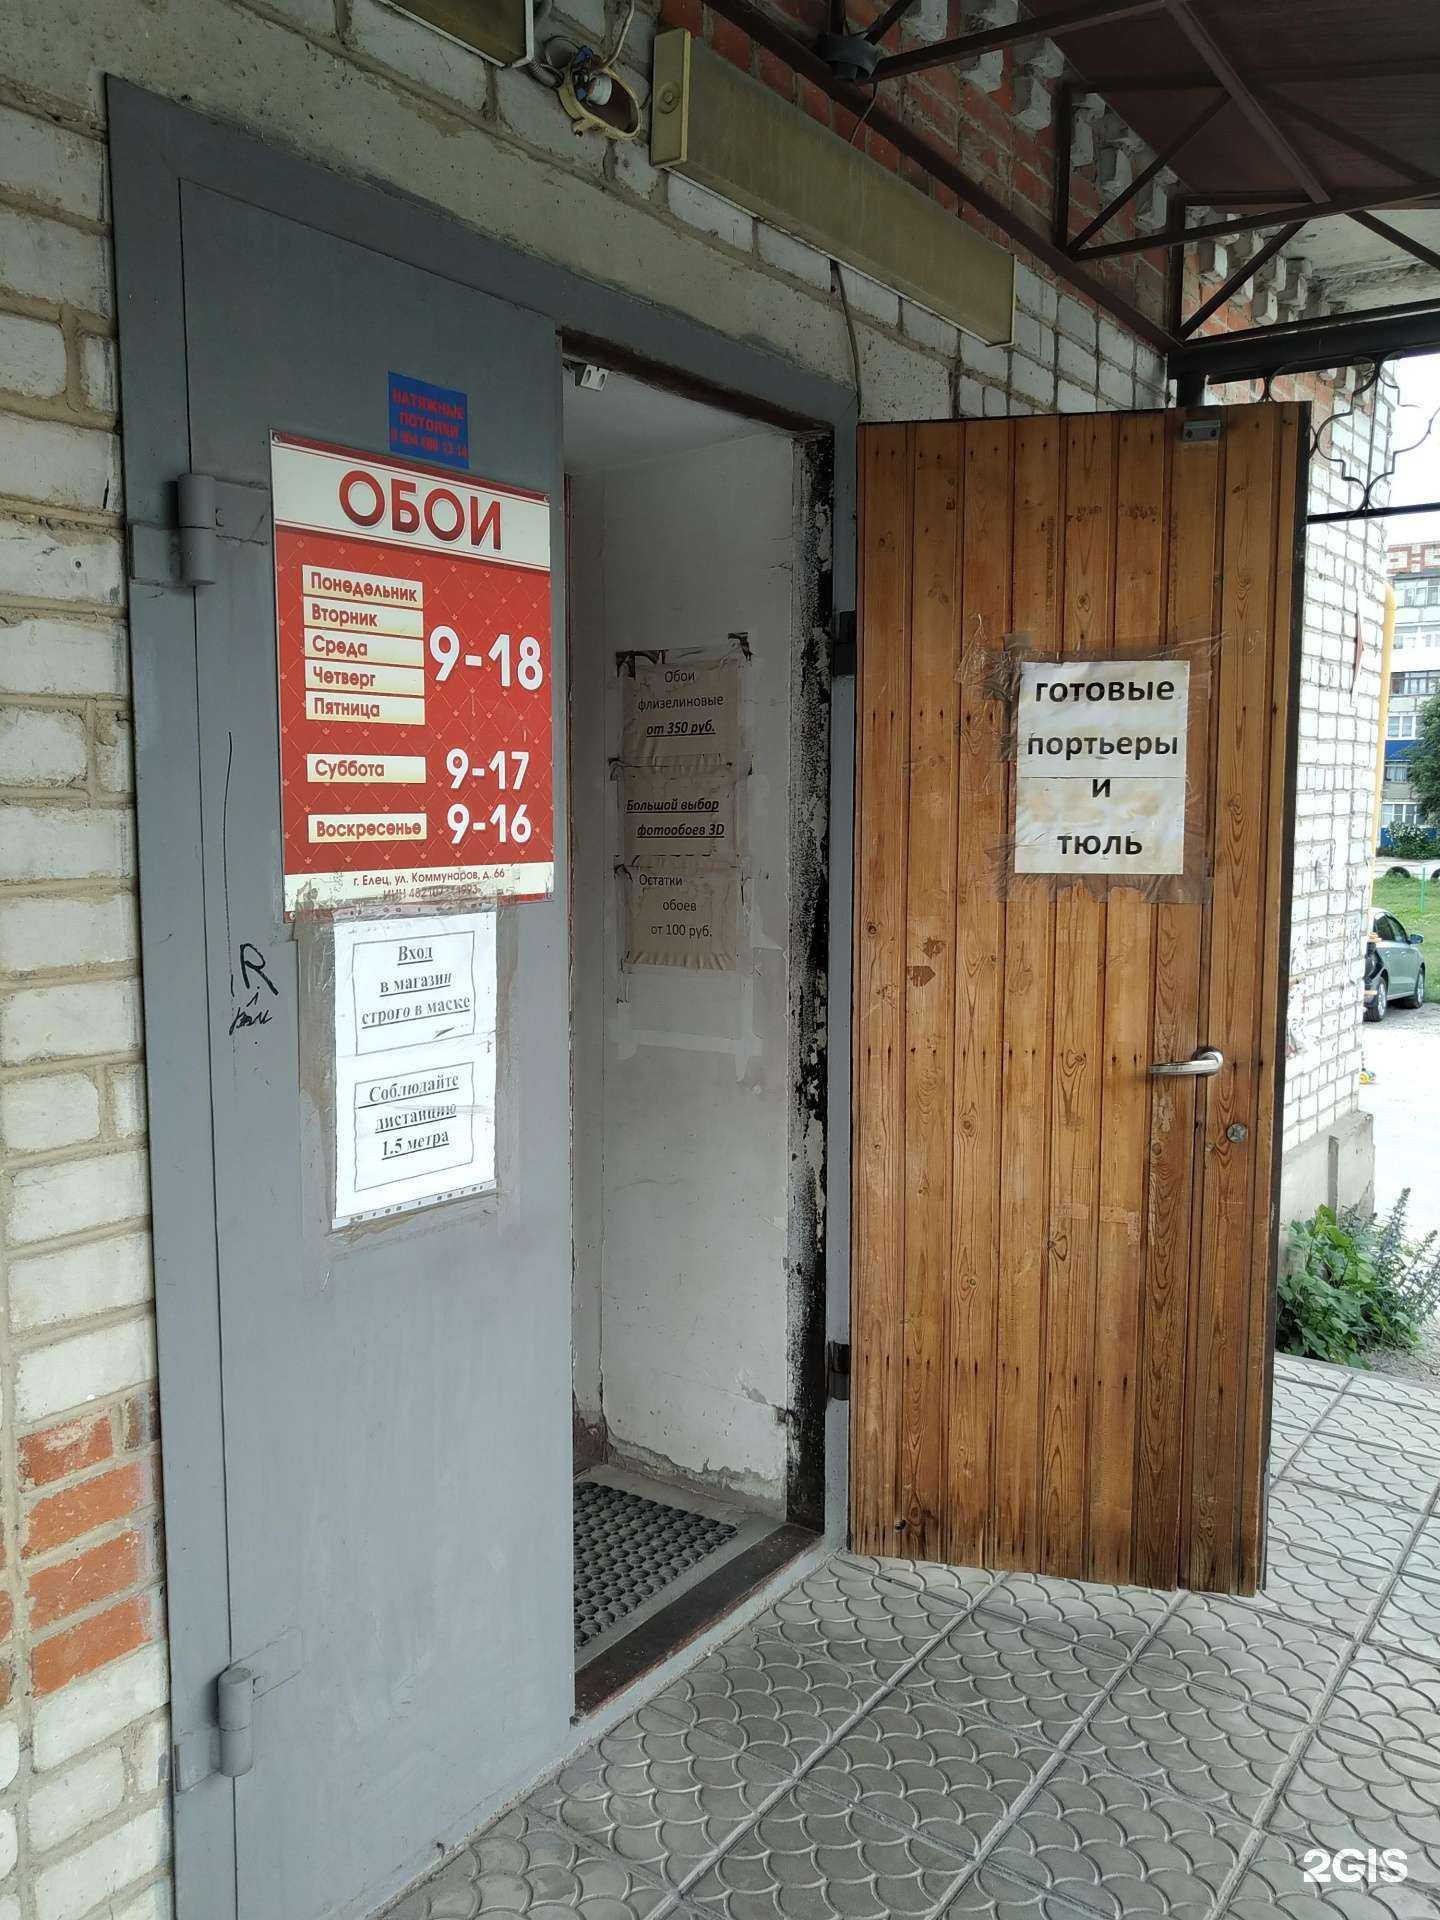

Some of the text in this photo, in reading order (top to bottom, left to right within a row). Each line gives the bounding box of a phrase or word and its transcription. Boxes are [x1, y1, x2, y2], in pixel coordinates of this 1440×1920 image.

[339, 470, 502, 550] ОБОИ
[310, 572, 418, 602] Понедельник
[311, 603, 378, 627] Вторник
[312, 635, 368, 658] Среда
[429, 625, 544, 691] 9-18
[312, 666, 376, 690] Четверг
[663, 670, 696, 684] Обои
[1034, 679, 1176, 703] готовые
[313, 697, 381, 718] Пятница
[637, 694, 725, 713] флизелиновые
[646, 719, 716, 738] от 350 руб.
[1027, 735, 1178, 761] портьеры
[314, 759, 385, 780] Суббота
[446, 748, 530, 790] 9-17
[1091, 777, 1112, 799] и
[626, 798, 720, 815] Большой выбор
[316, 820, 422, 840] Воскресенье
[447, 803, 532, 844] 9-16
[636, 821, 726, 839] фотообоев 3D
[1056, 834, 1143, 855] тюль
[395, 874, 409, 887] ул.
[493, 868, 506, 879] 66
[638, 872, 683, 887] Остатки
[662, 898, 698, 912] обоев
[650, 922, 714, 940] от 100 руб.
[398, 944, 433, 962] Вход
[380, 971, 452, 993] в магазин
[361, 996, 471, 1027] строго в маске
[369, 1073, 460, 1103] Соблюдайте
[375, 1103, 457, 1131] дистанцию
[406, 1128, 450, 1152] метра
